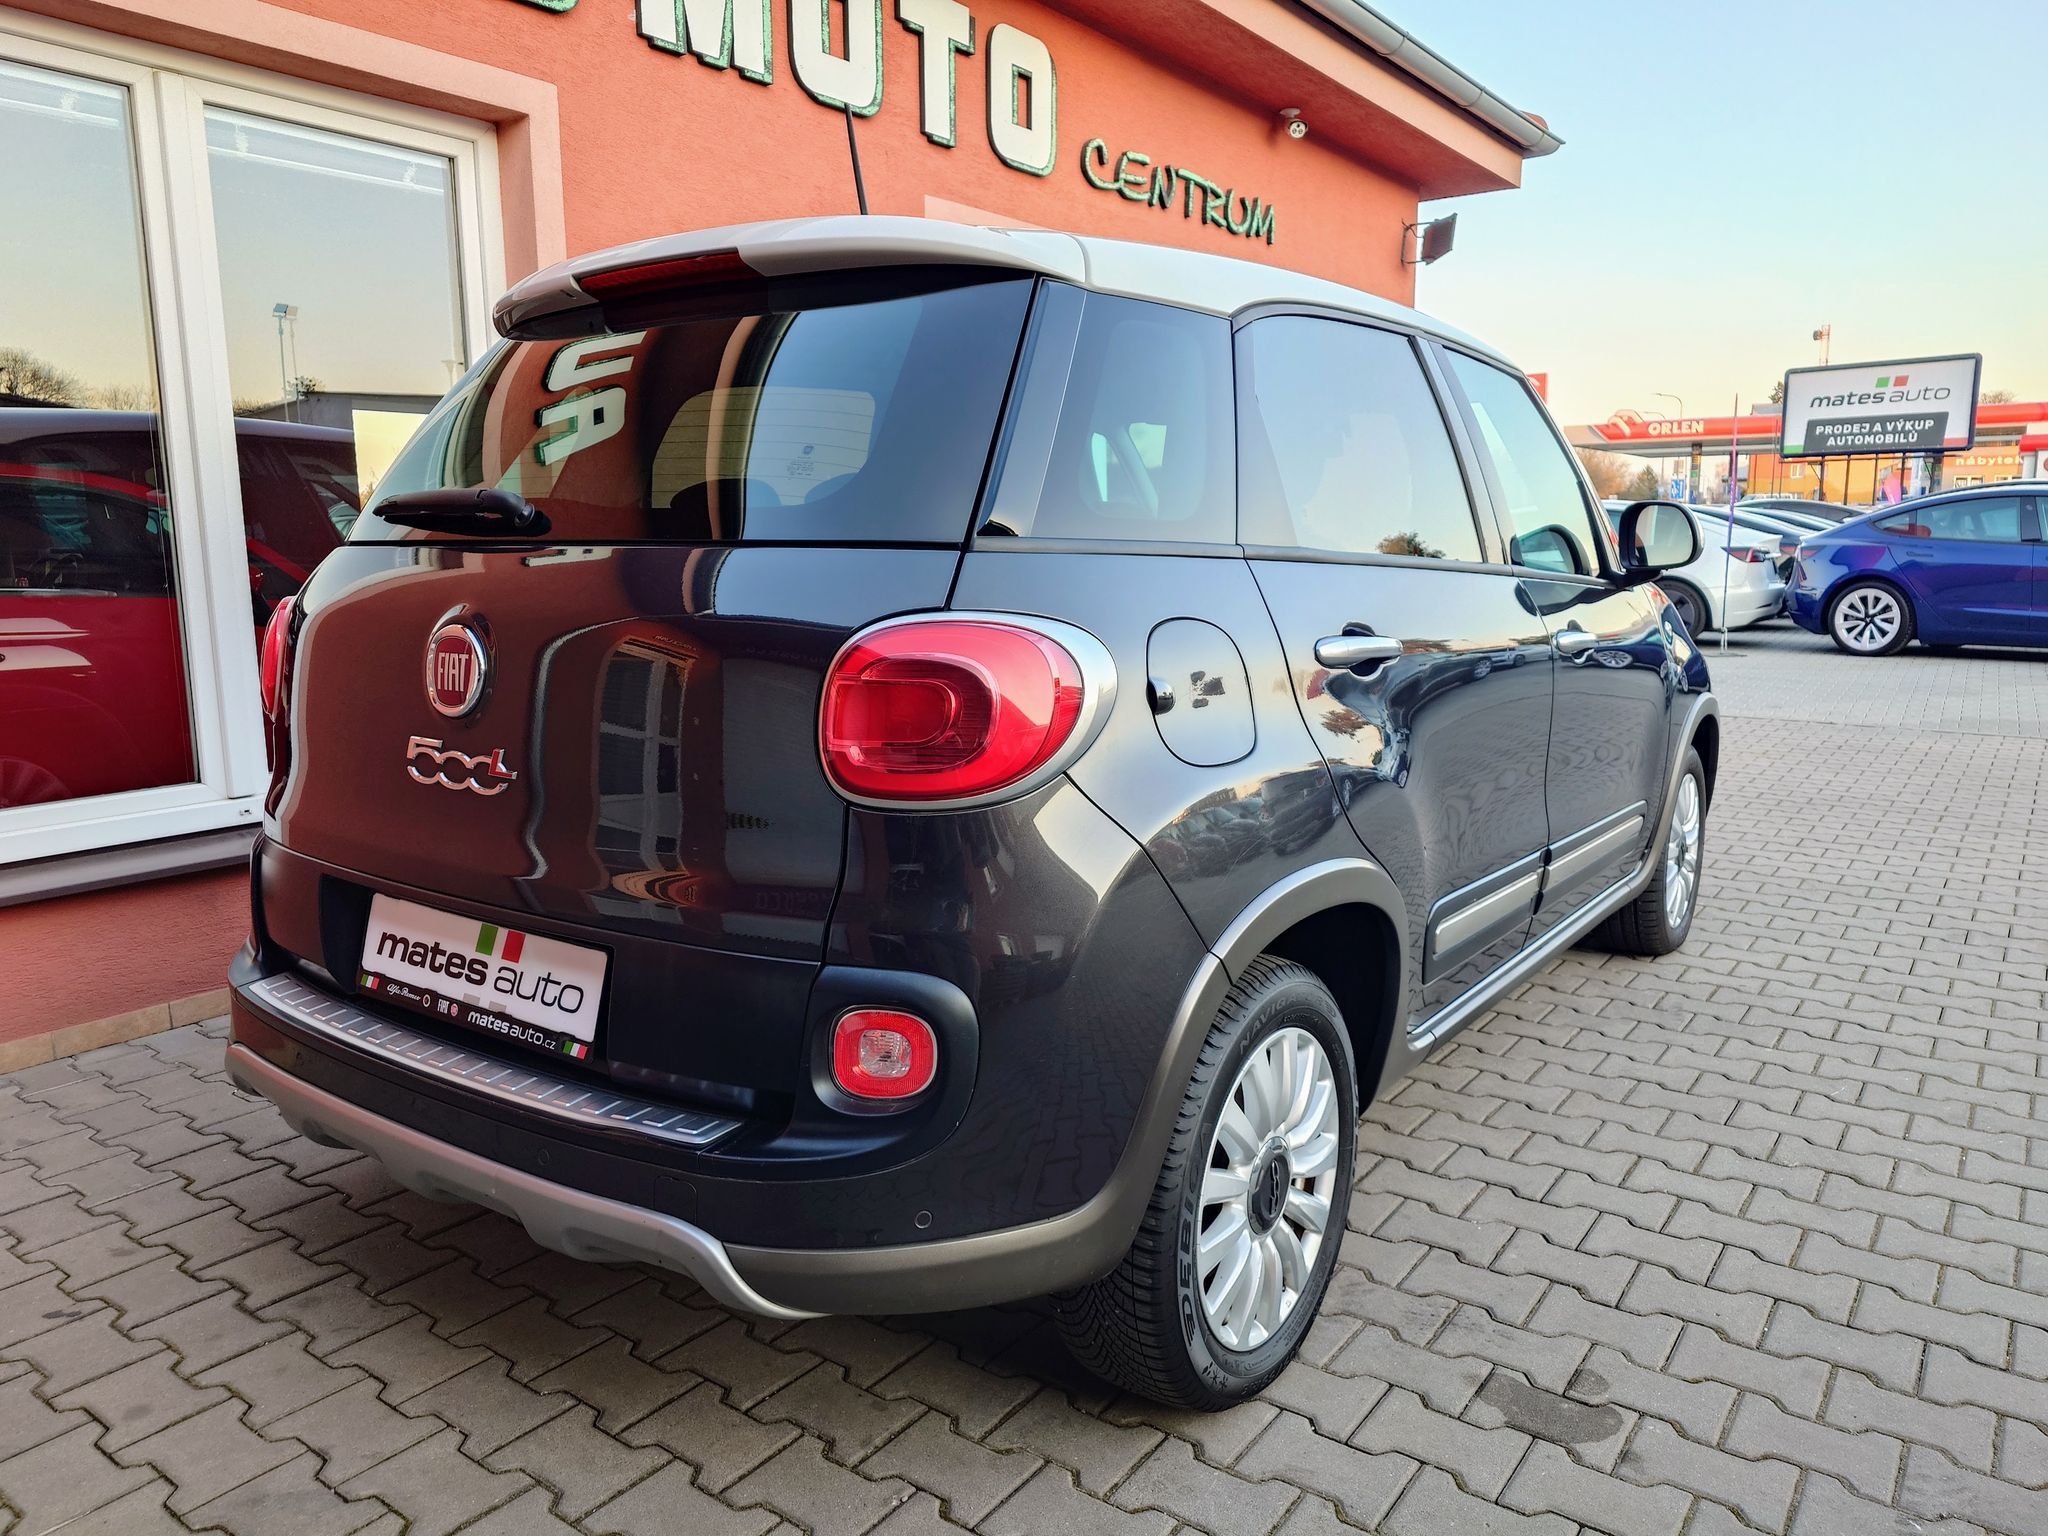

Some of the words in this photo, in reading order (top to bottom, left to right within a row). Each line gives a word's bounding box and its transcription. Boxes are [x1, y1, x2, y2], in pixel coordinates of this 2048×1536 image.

[1080, 138, 1275, 245] CENTRUM
[1810, 391, 1886, 408] mates
[1888, 386, 1951, 403] auto
[1647, 420, 1705, 436] ORLEN
[1815, 422, 1870, 435] PRODEJ
[1872, 422, 1882, 432] A
[1886, 418, 1935, 432] VÝKUP
[1826, 431, 1918, 446] AUTOMOBILŮ
[437, 652, 469, 692] FIAT
[406, 735, 518, 796] 500L
[376, 931, 489, 986] mates
[493, 965, 584, 1014] auto
